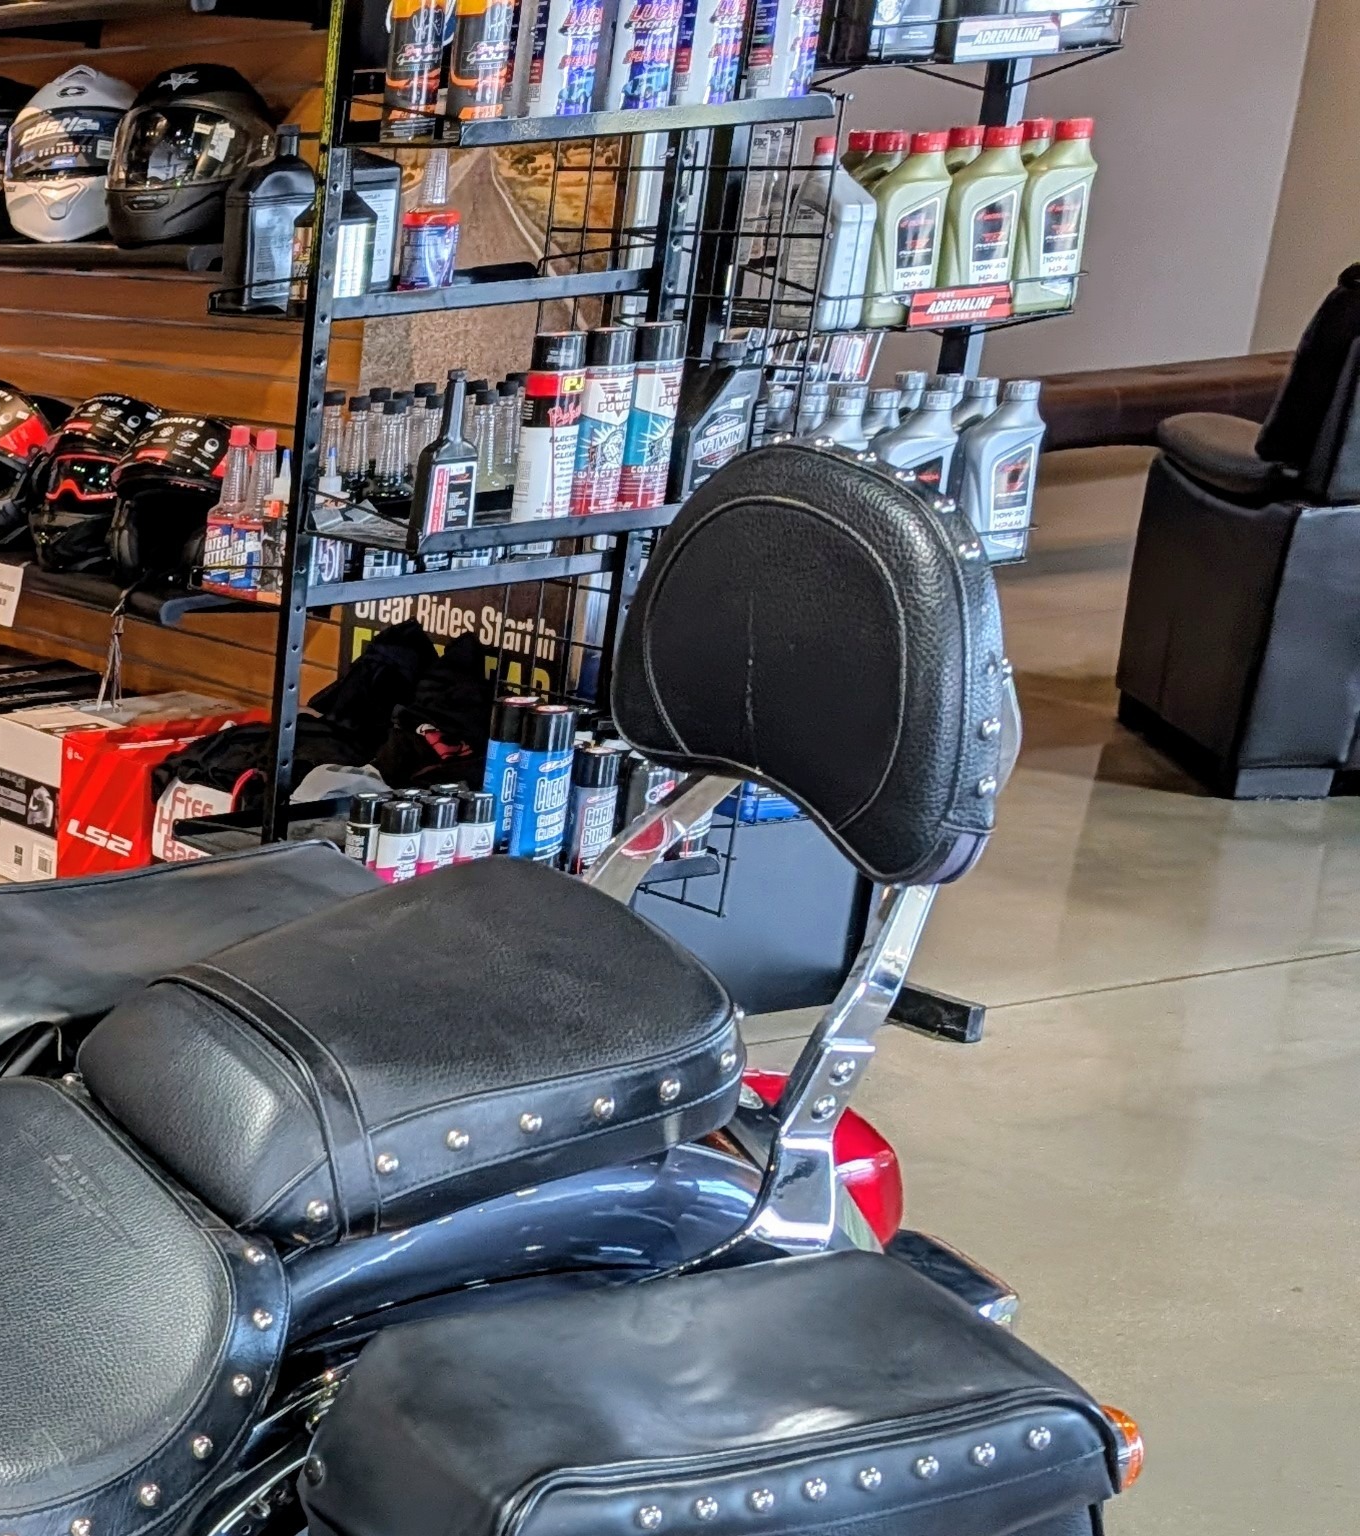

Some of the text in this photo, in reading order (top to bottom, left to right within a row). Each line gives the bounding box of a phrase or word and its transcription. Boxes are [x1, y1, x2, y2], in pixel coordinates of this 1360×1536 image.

[972, 26, 1044, 46] ADRENALINE
[927, 295, 996, 315] ADRENALINE
[700, 429, 741, 455] V-TWIN
[416, 594, 476, 639] Rides
[480, 605, 535, 655] Start
[66, 818, 133, 857] LS2
